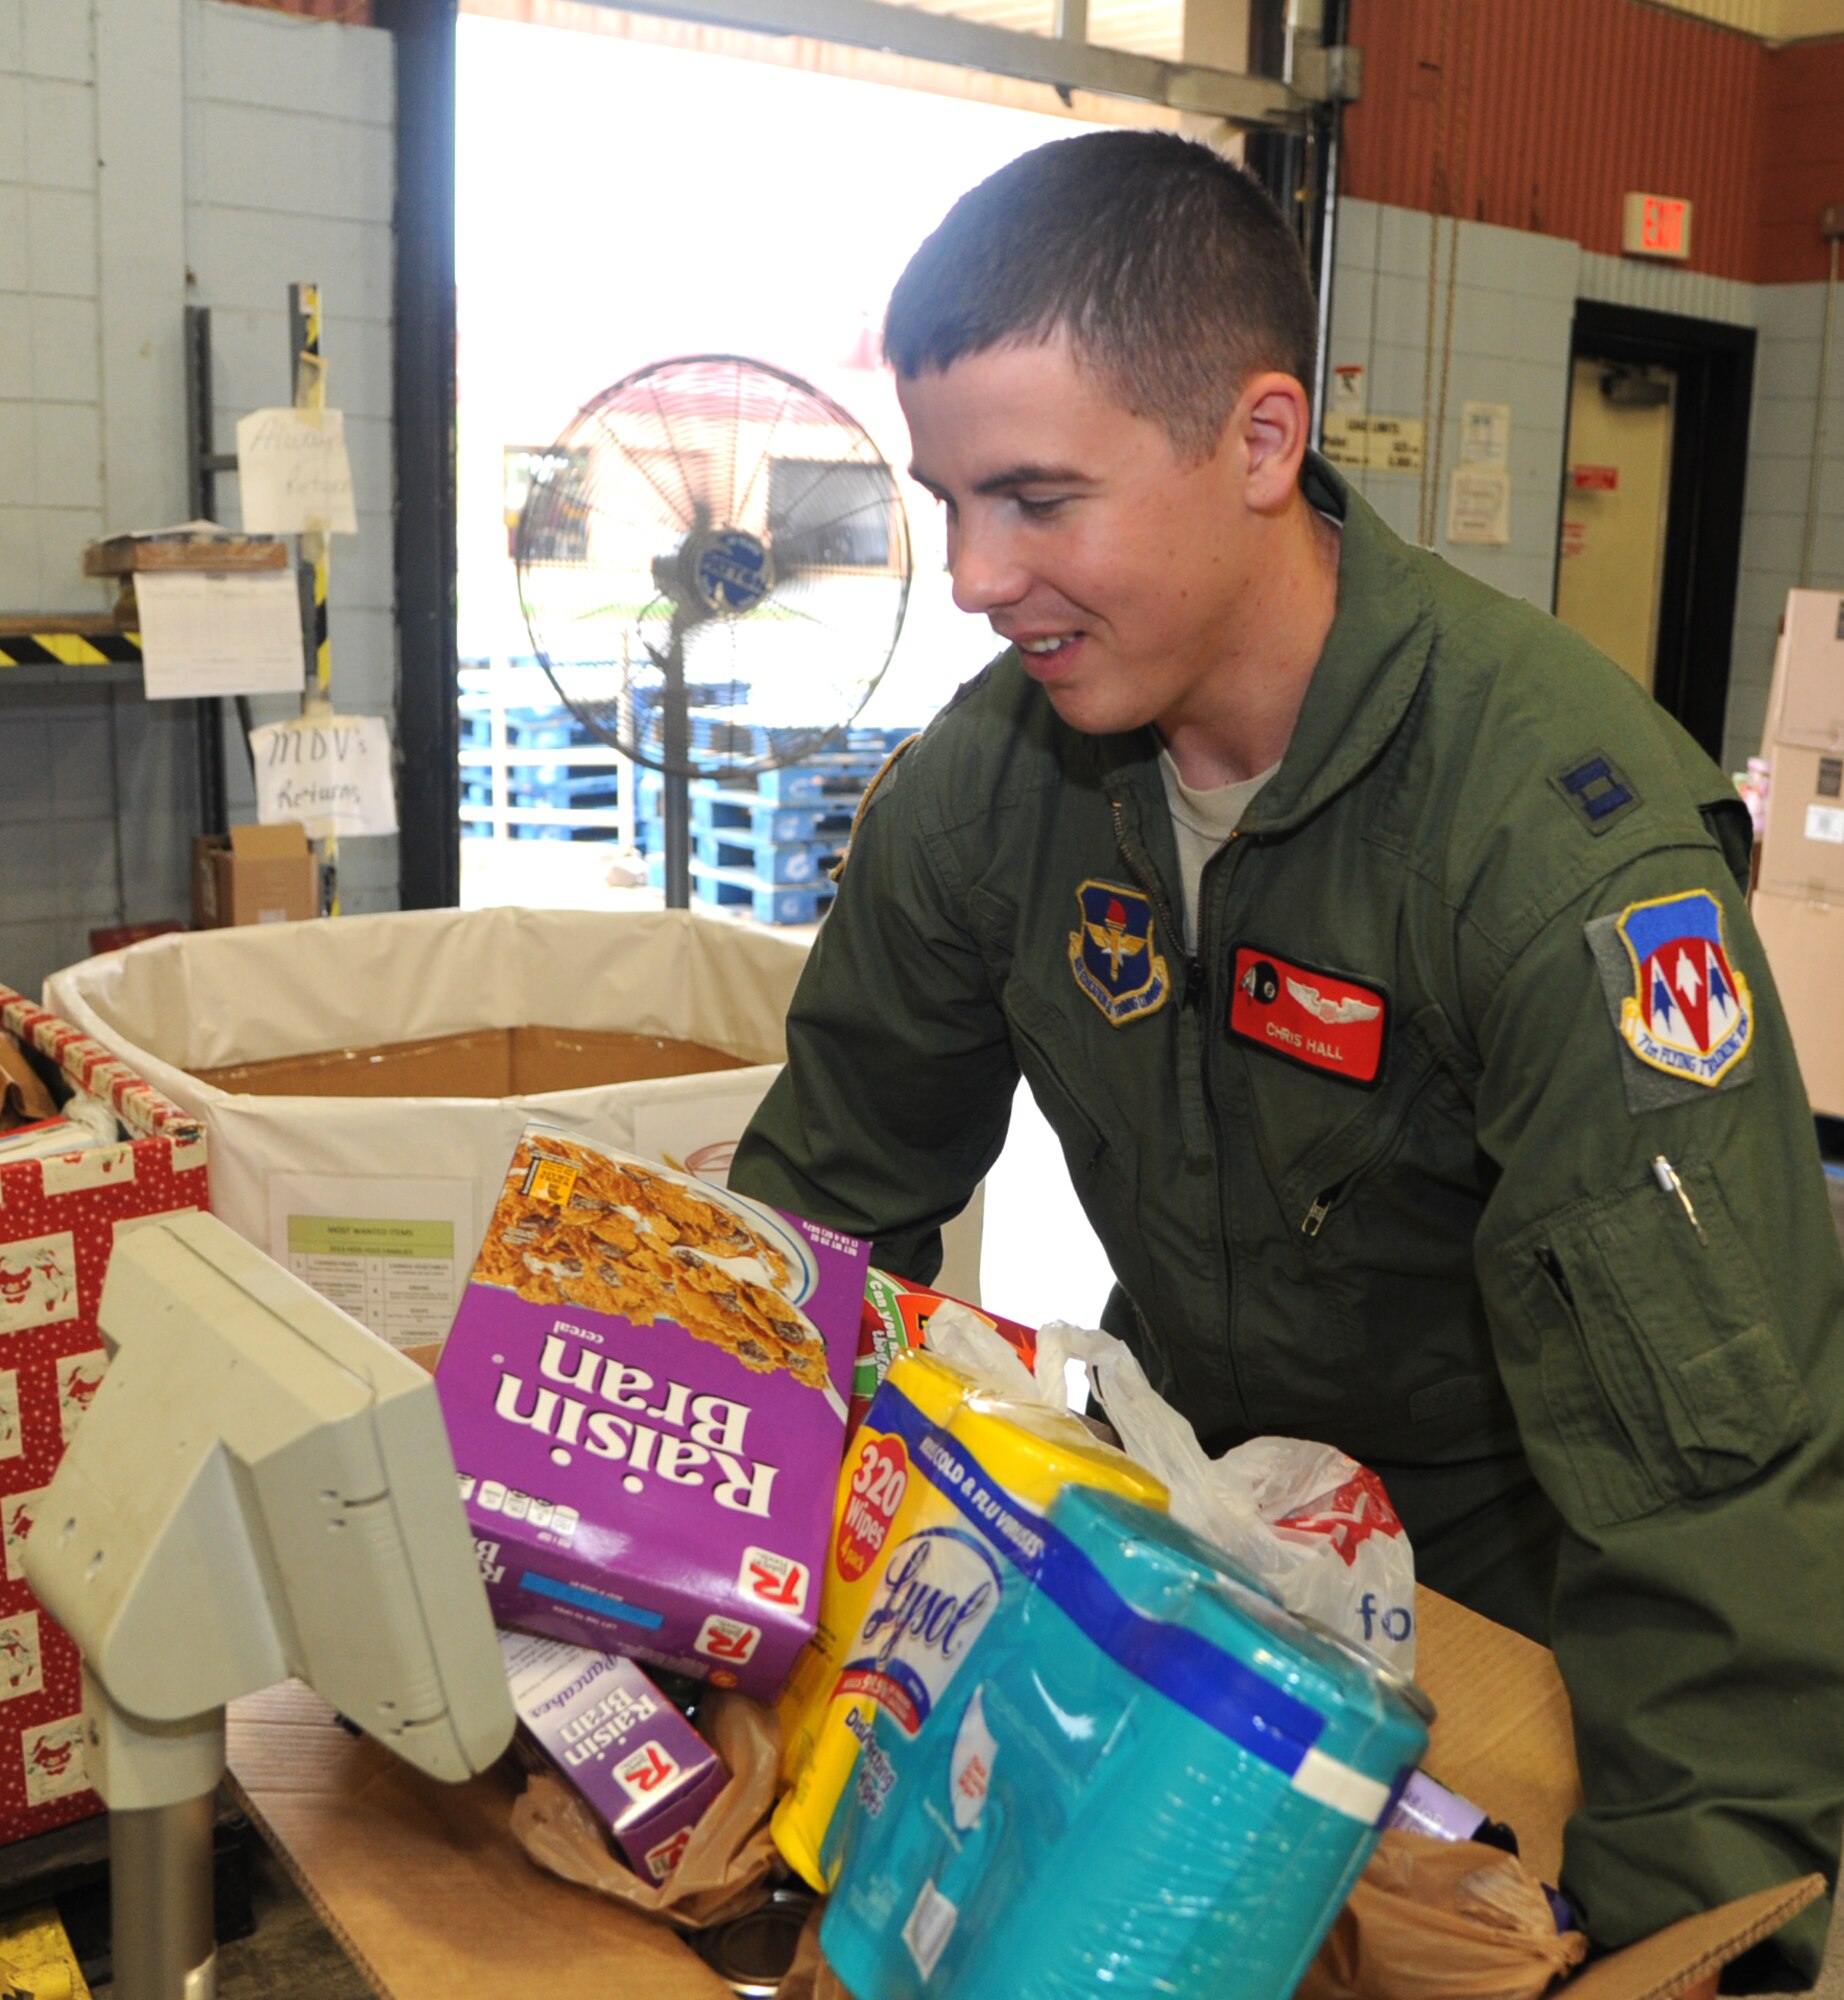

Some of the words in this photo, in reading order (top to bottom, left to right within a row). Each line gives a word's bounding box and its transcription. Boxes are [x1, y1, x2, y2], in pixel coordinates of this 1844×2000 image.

[1643, 197, 1683, 254] EXIT
[269, 728, 367, 768] MDV's
[278, 778, 361, 810] Returns
[1266, 1021, 1303, 1048] CHRIS
[1306, 1038, 1344, 1061] HALL
[327, 1225, 350, 1235] MOST
[352, 1227, 387, 1236] WANTED
[389, 1227, 414, 1237] ITEMS
[869, 1280, 887, 1308] Can
[553, 1320, 605, 1345] cereal
[877, 1311, 896, 1339] you
[538, 1333, 752, 1456] Bran
[493, 1371, 780, 1518] Raisin
[853, 1444, 907, 1518] 320
[933, 1446, 966, 1485] COLD
[960, 1476, 977, 1498] &
[971, 1487, 1002, 1520] FLU
[995, 1509, 1046, 1559] VIRUSES
[840, 1535, 853, 1559] 4
[845, 1495, 886, 1552] Wipes
[862, 1540, 993, 1663] Lysol
[531, 1652, 618, 1718] Pancakes
[559, 1687, 634, 1744] Bran
[563, 1694, 658, 1767] Raisin
